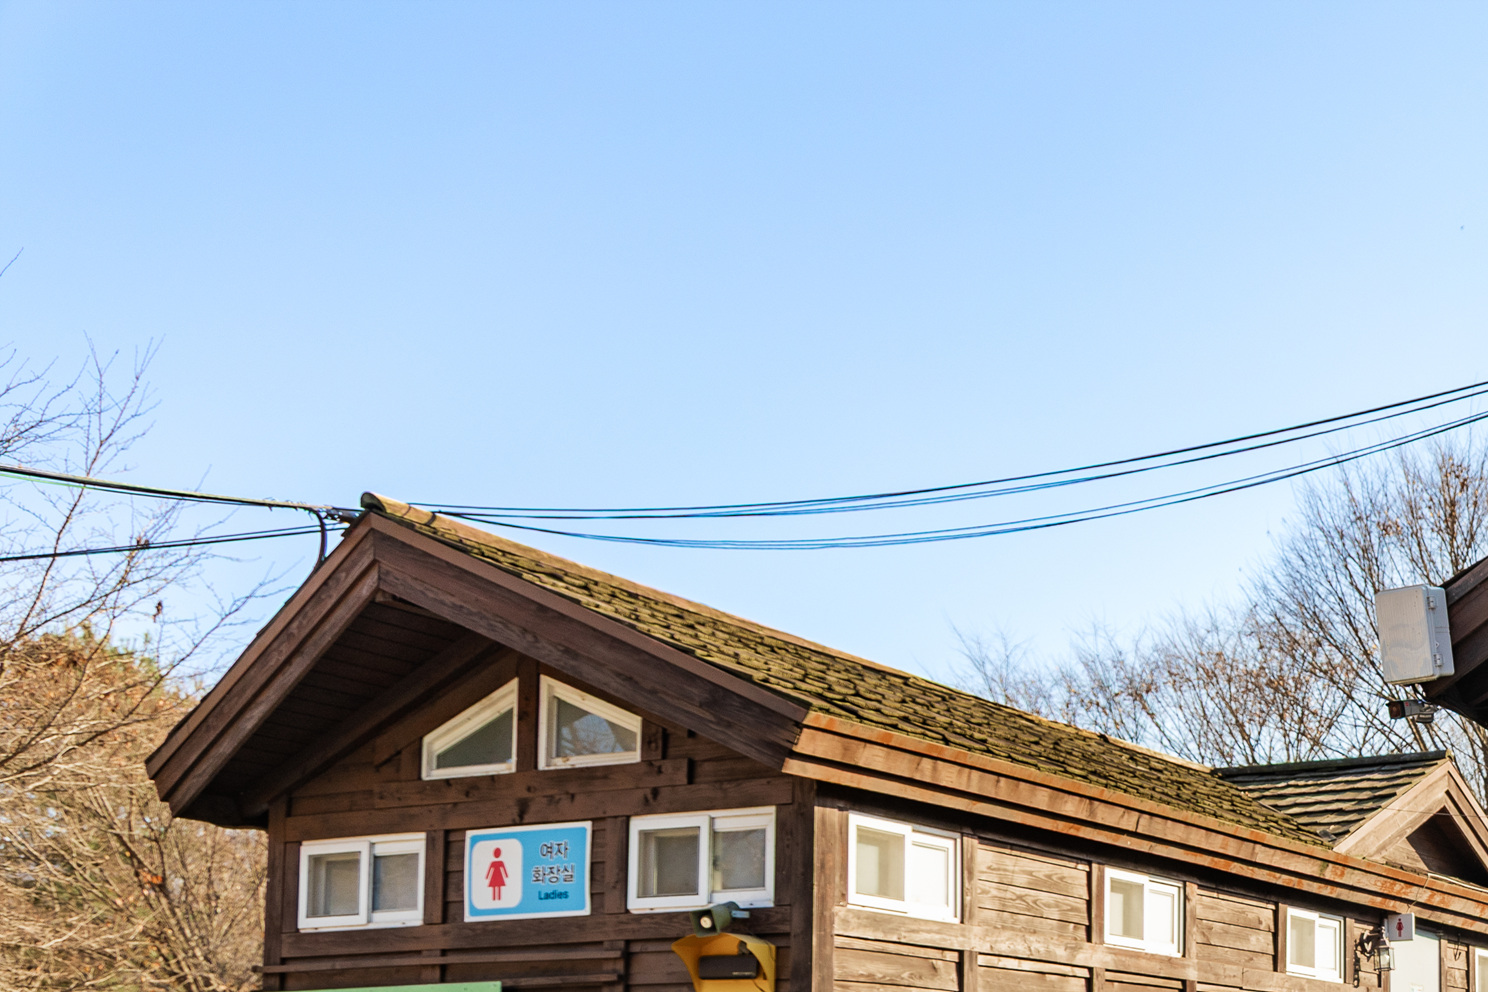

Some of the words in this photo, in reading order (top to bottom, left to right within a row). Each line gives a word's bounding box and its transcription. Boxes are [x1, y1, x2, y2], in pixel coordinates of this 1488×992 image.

[539, 841, 569, 860] 여자
[531, 864, 575, 884] 화장실
[538, 890, 570, 901] Ladies
